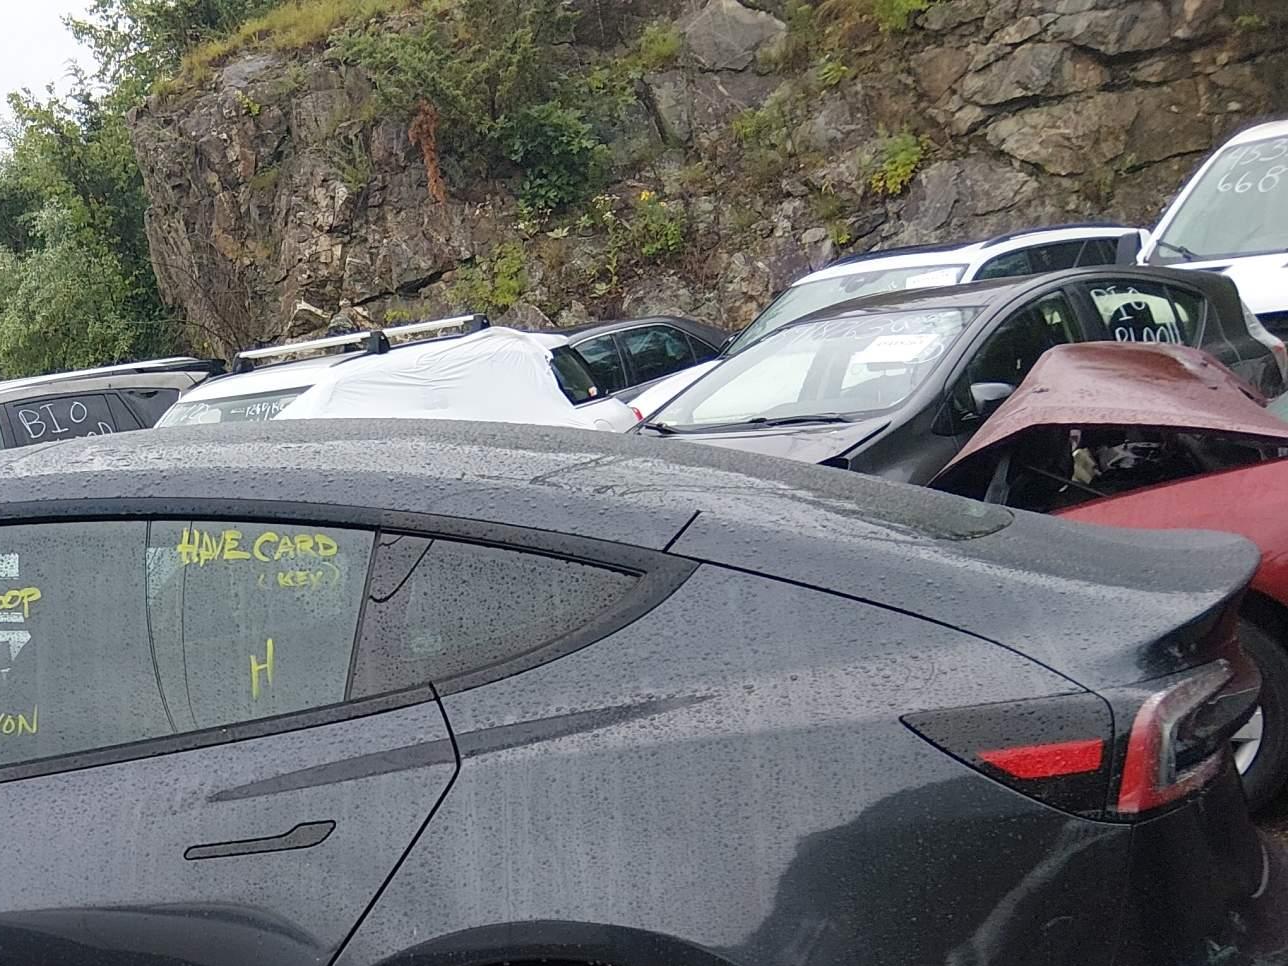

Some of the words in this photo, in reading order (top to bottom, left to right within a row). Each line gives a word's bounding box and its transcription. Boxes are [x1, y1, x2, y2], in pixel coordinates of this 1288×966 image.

[18, 401, 88, 439] BIO
[177, 527, 252, 567] HAVE
[253, 531, 338, 562] CARD
[250, 638, 275, 700] H
